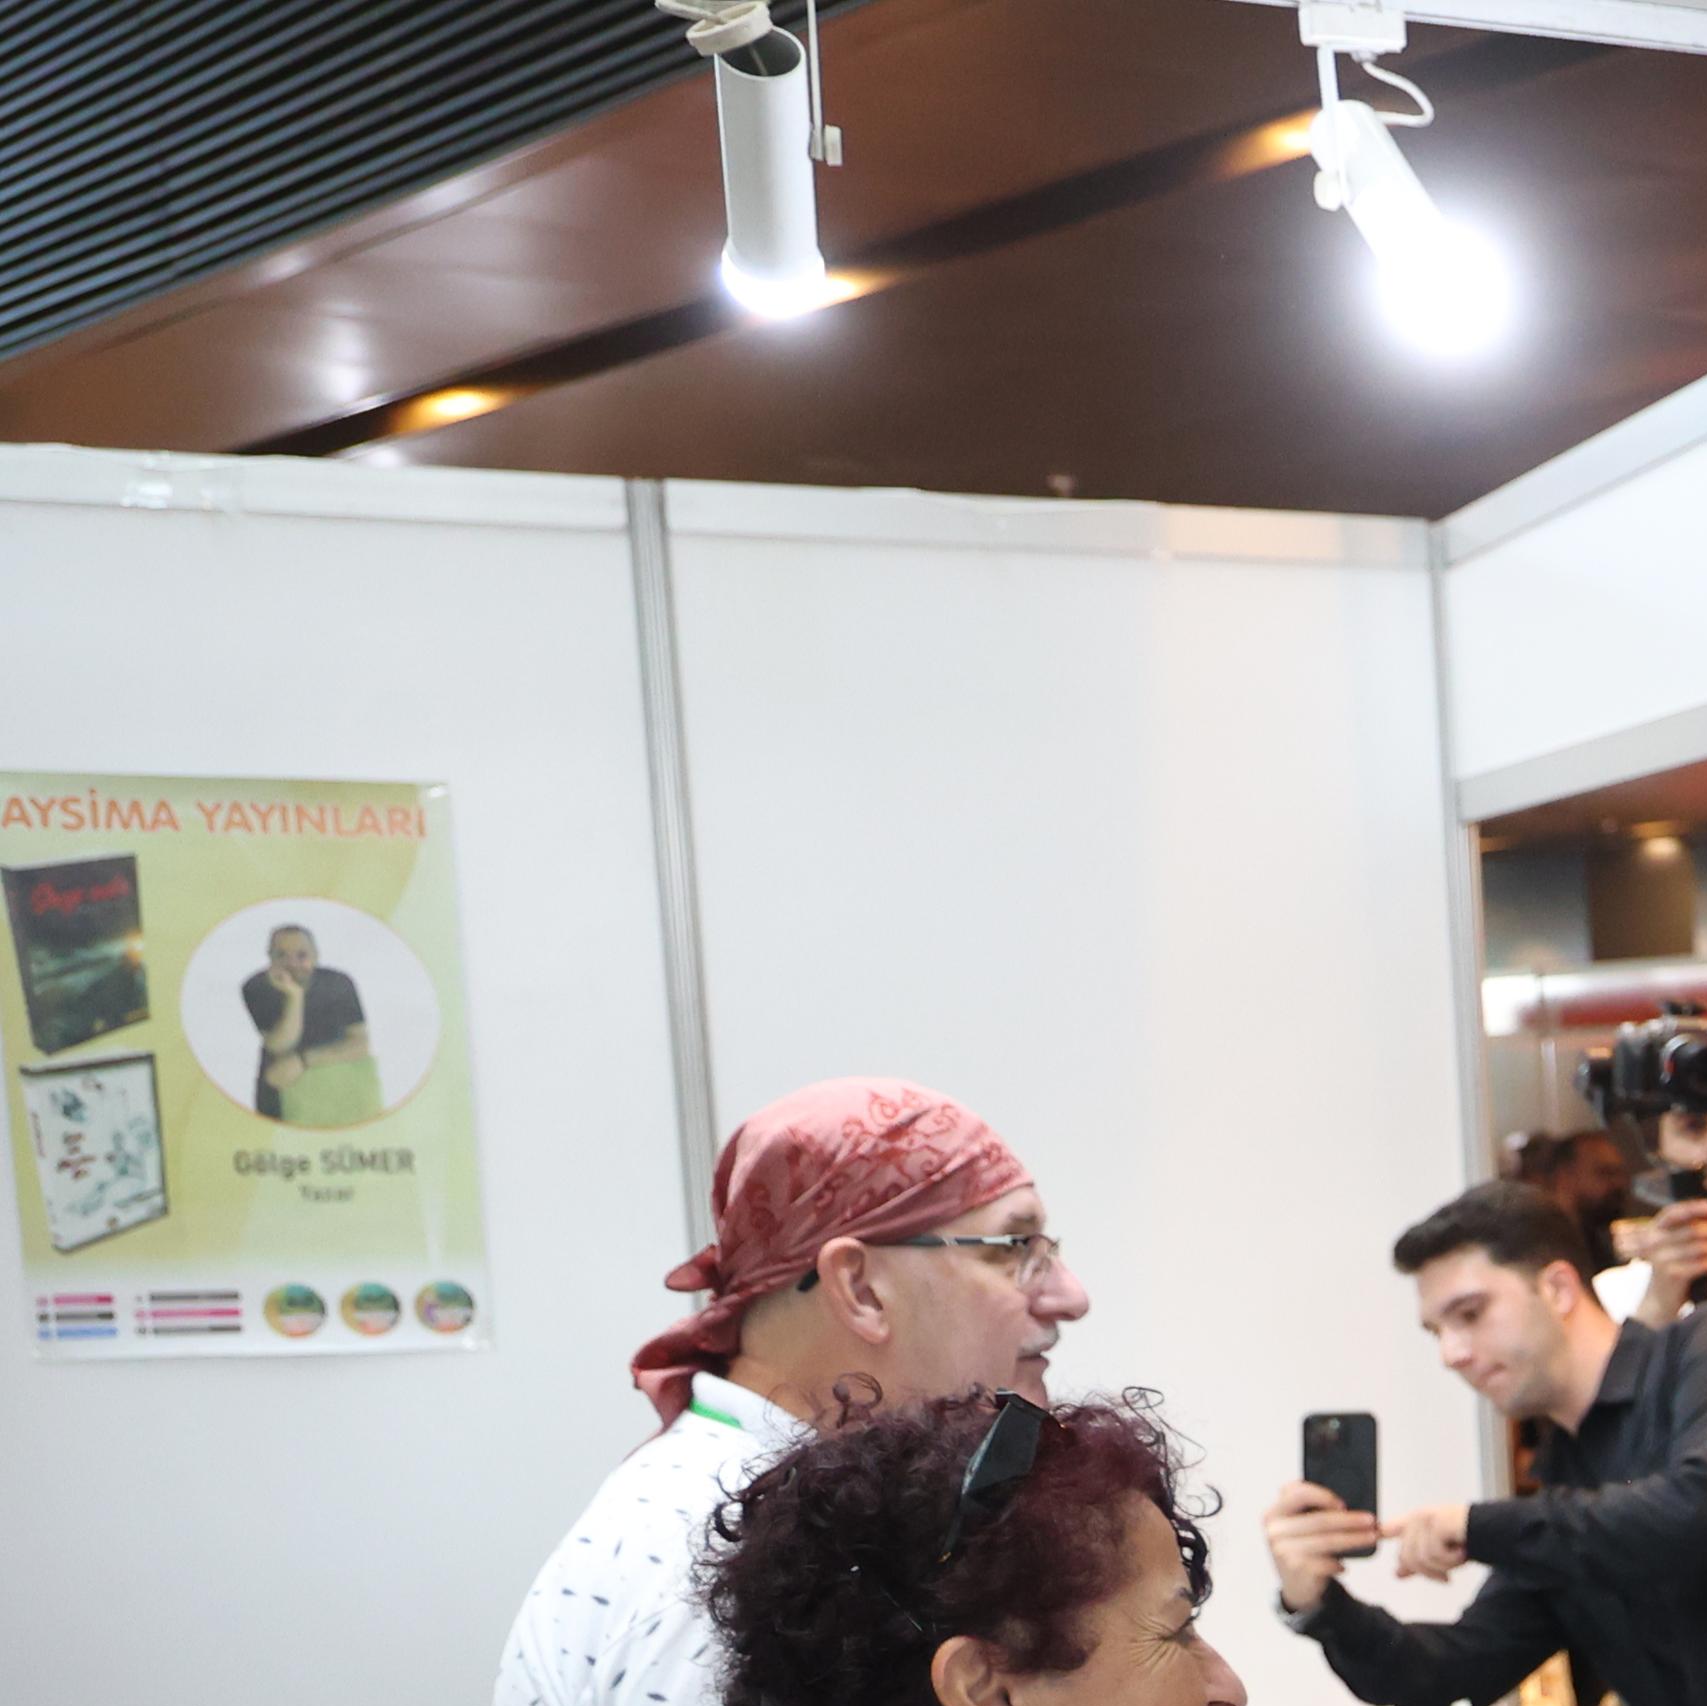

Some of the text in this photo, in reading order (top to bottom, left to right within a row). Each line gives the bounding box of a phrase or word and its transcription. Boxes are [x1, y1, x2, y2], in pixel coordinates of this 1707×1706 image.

[1, 788, 427, 840] AYSİMA YAYINLARI
[233, 1146, 416, 1178] Gölge SÜMER
